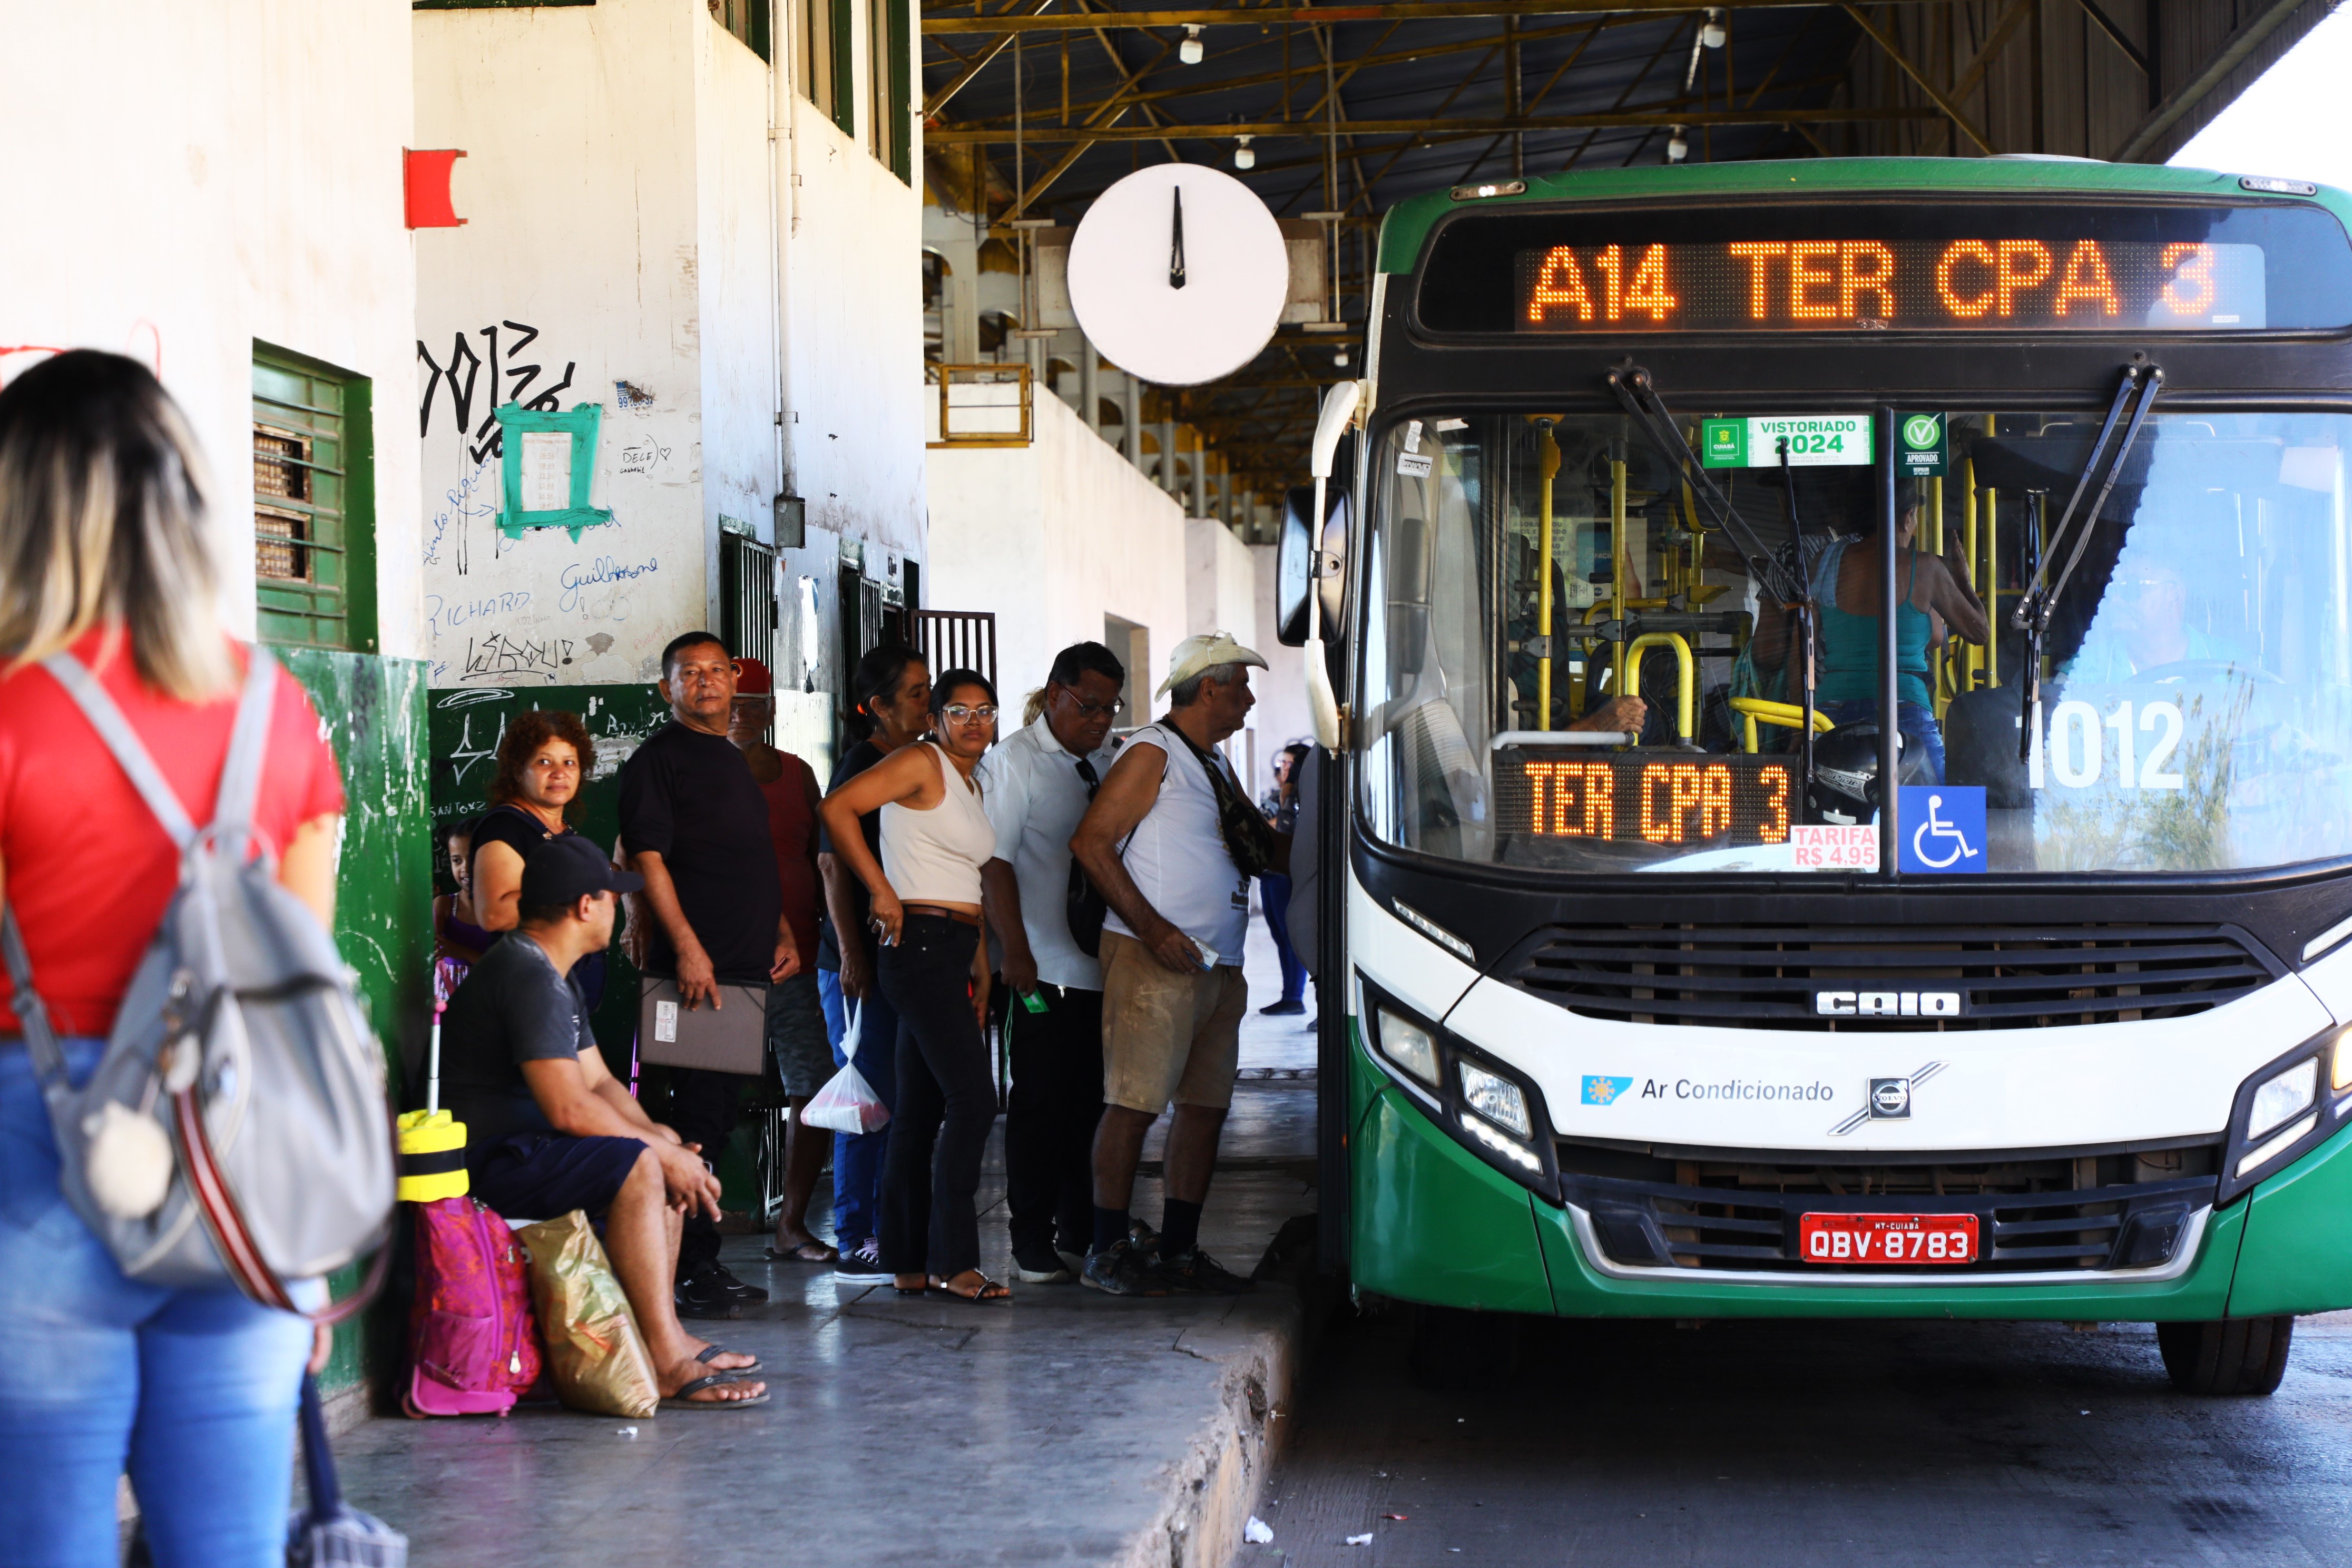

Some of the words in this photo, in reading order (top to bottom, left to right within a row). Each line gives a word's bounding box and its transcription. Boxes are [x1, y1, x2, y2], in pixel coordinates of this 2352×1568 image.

[1530, 244, 1677, 320] A14
[1731, 240, 1894, 318] TER
[1937, 239, 2118, 316] CPA
[2163, 242, 2213, 315] 3
[1760, 420, 1856, 434] VISTORIADO
[1775, 434, 1844, 454] 2024
[1907, 454, 1938, 463] APROVADO
[425, 592, 531, 636] RICHARD
[2015, 701, 2183, 789] 1012
[1524, 762, 1613, 841] TER
[1642, 763, 1731, 843] CPA
[1760, 766, 1789, 844] 3
[1795, 828, 1876, 846] TARIFA
[1796, 847, 1823, 866] R$
[1830, 847, 1875, 867] 4,95
[1817, 992, 1959, 1016] CAIO
[1641, 1079, 1668, 1100] Ar
[1675, 1079, 1834, 1102] Condicionado
